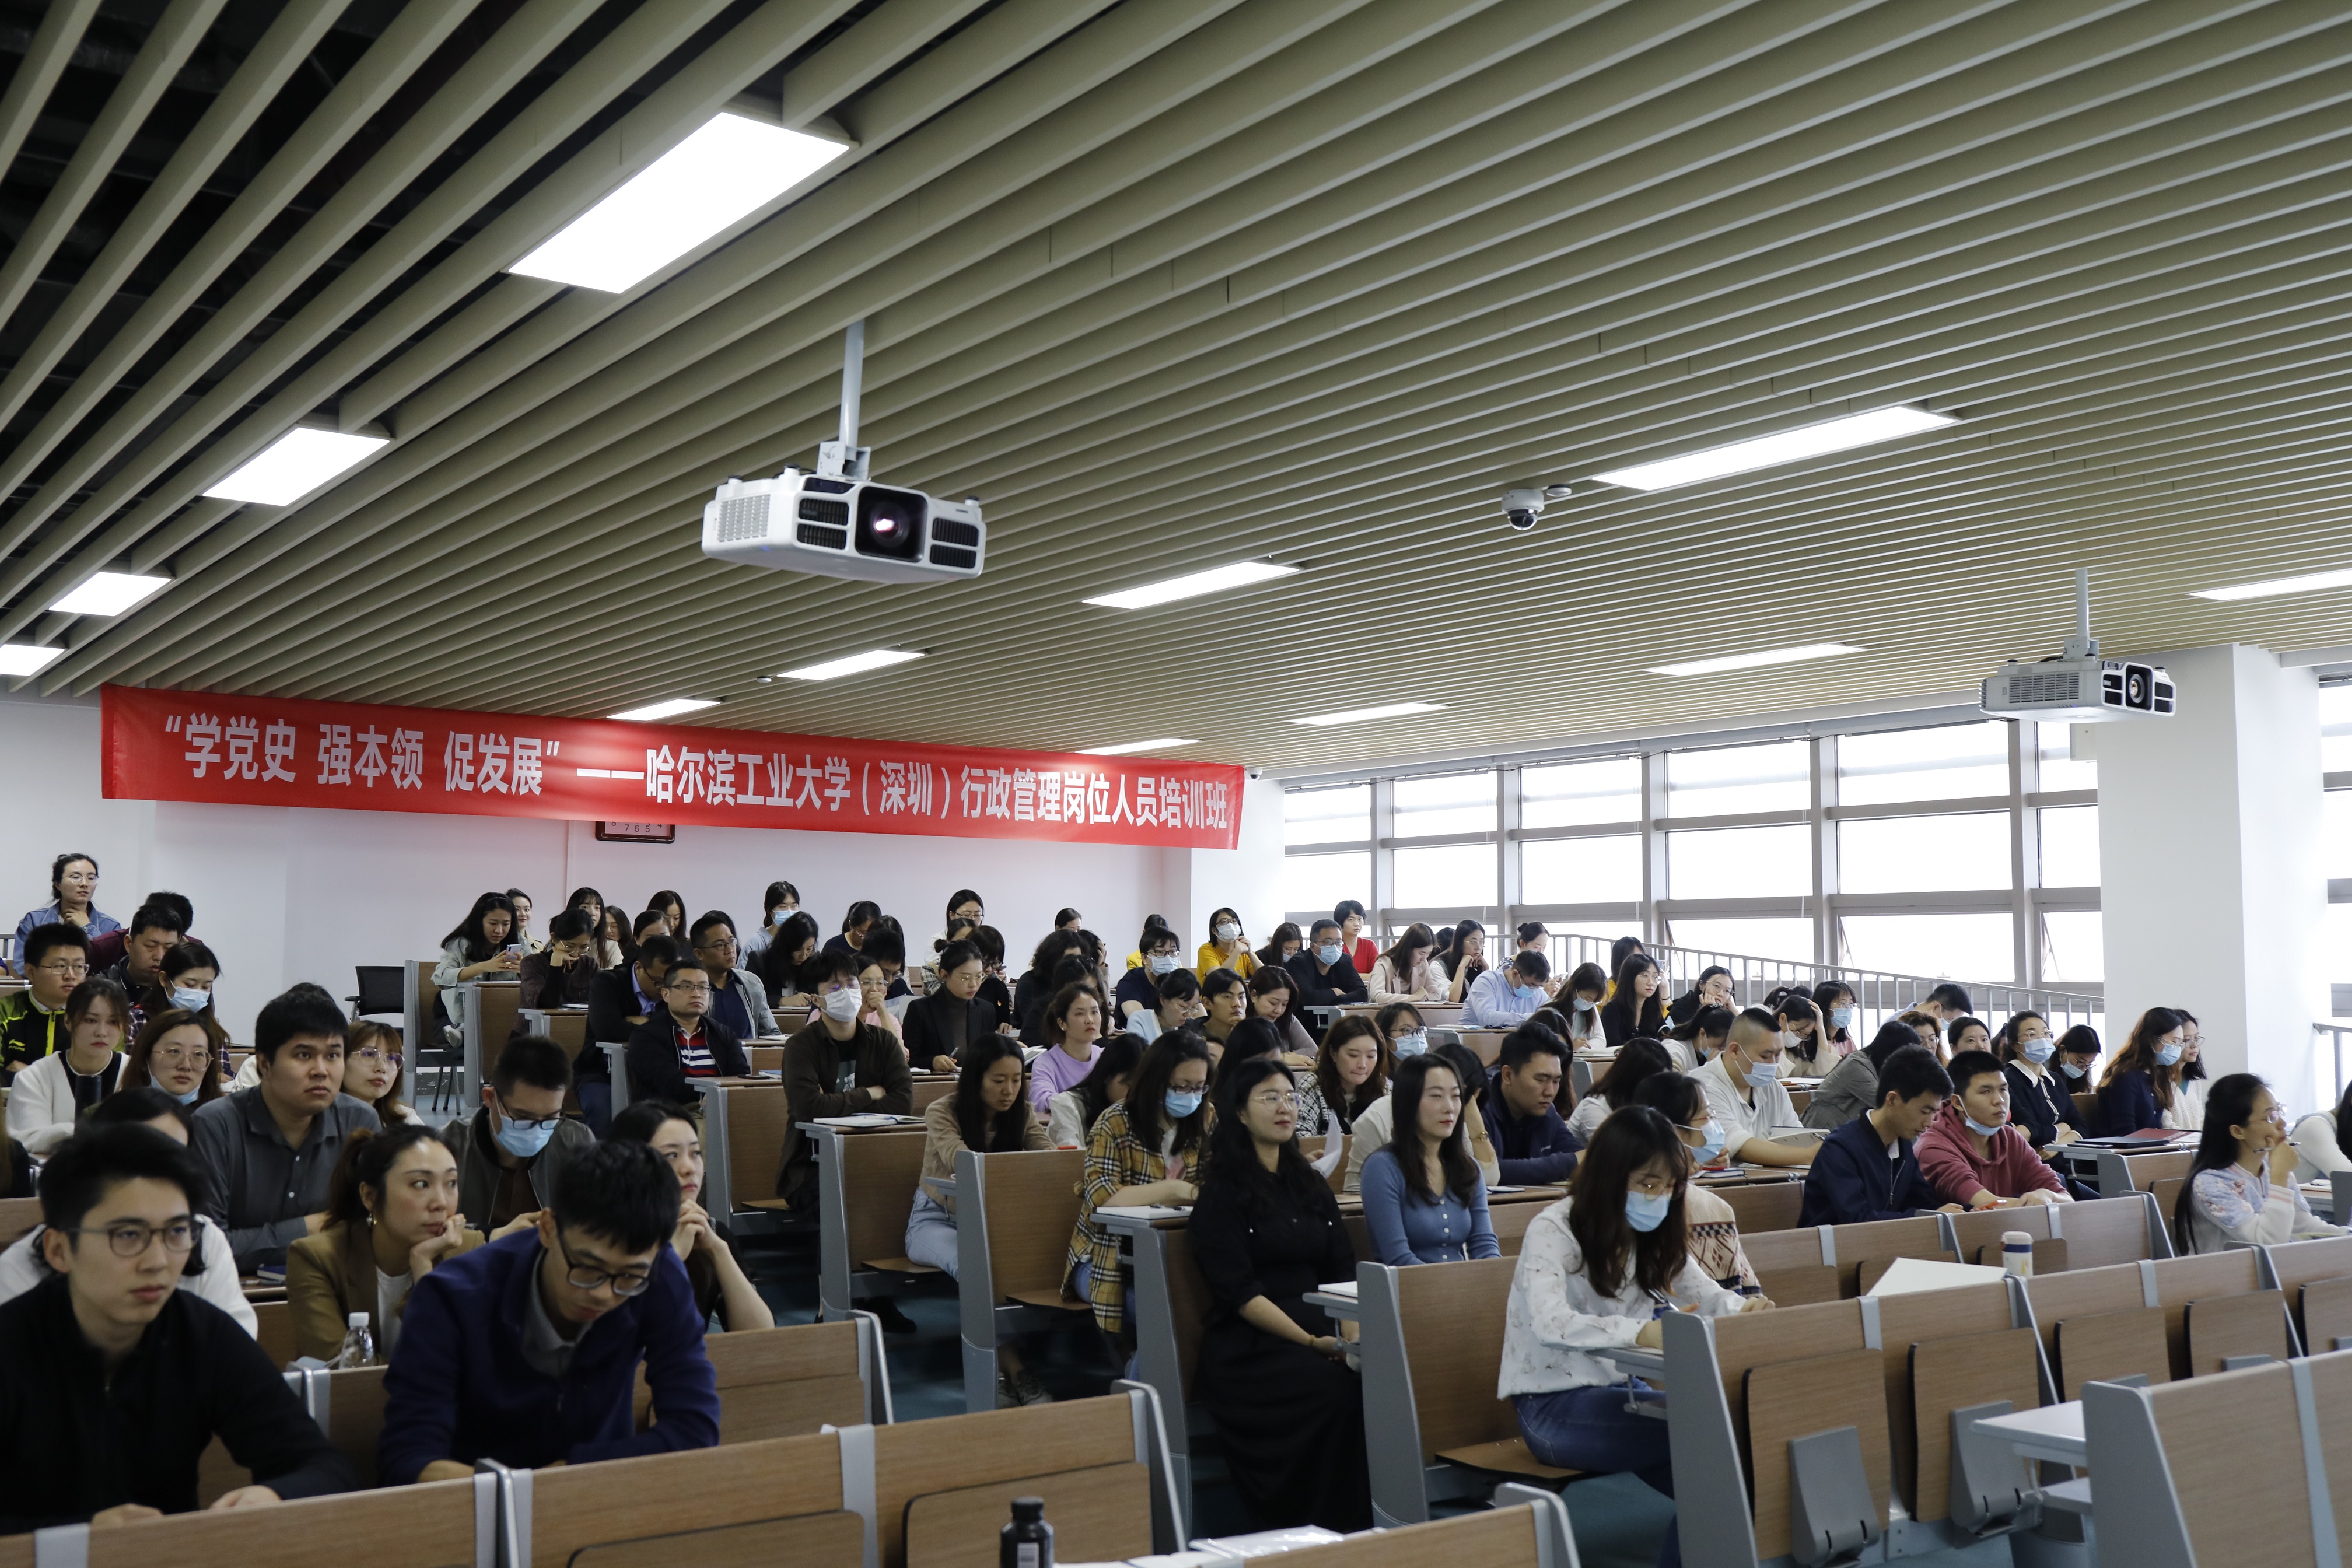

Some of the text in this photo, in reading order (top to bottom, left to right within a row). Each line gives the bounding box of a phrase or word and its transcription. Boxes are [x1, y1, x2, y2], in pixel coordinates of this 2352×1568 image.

[318, 724, 422, 790] 强本领
[624, 824, 629, 832] 7
[634, 824, 640, 832] 6
[645, 825, 650, 833] 5
